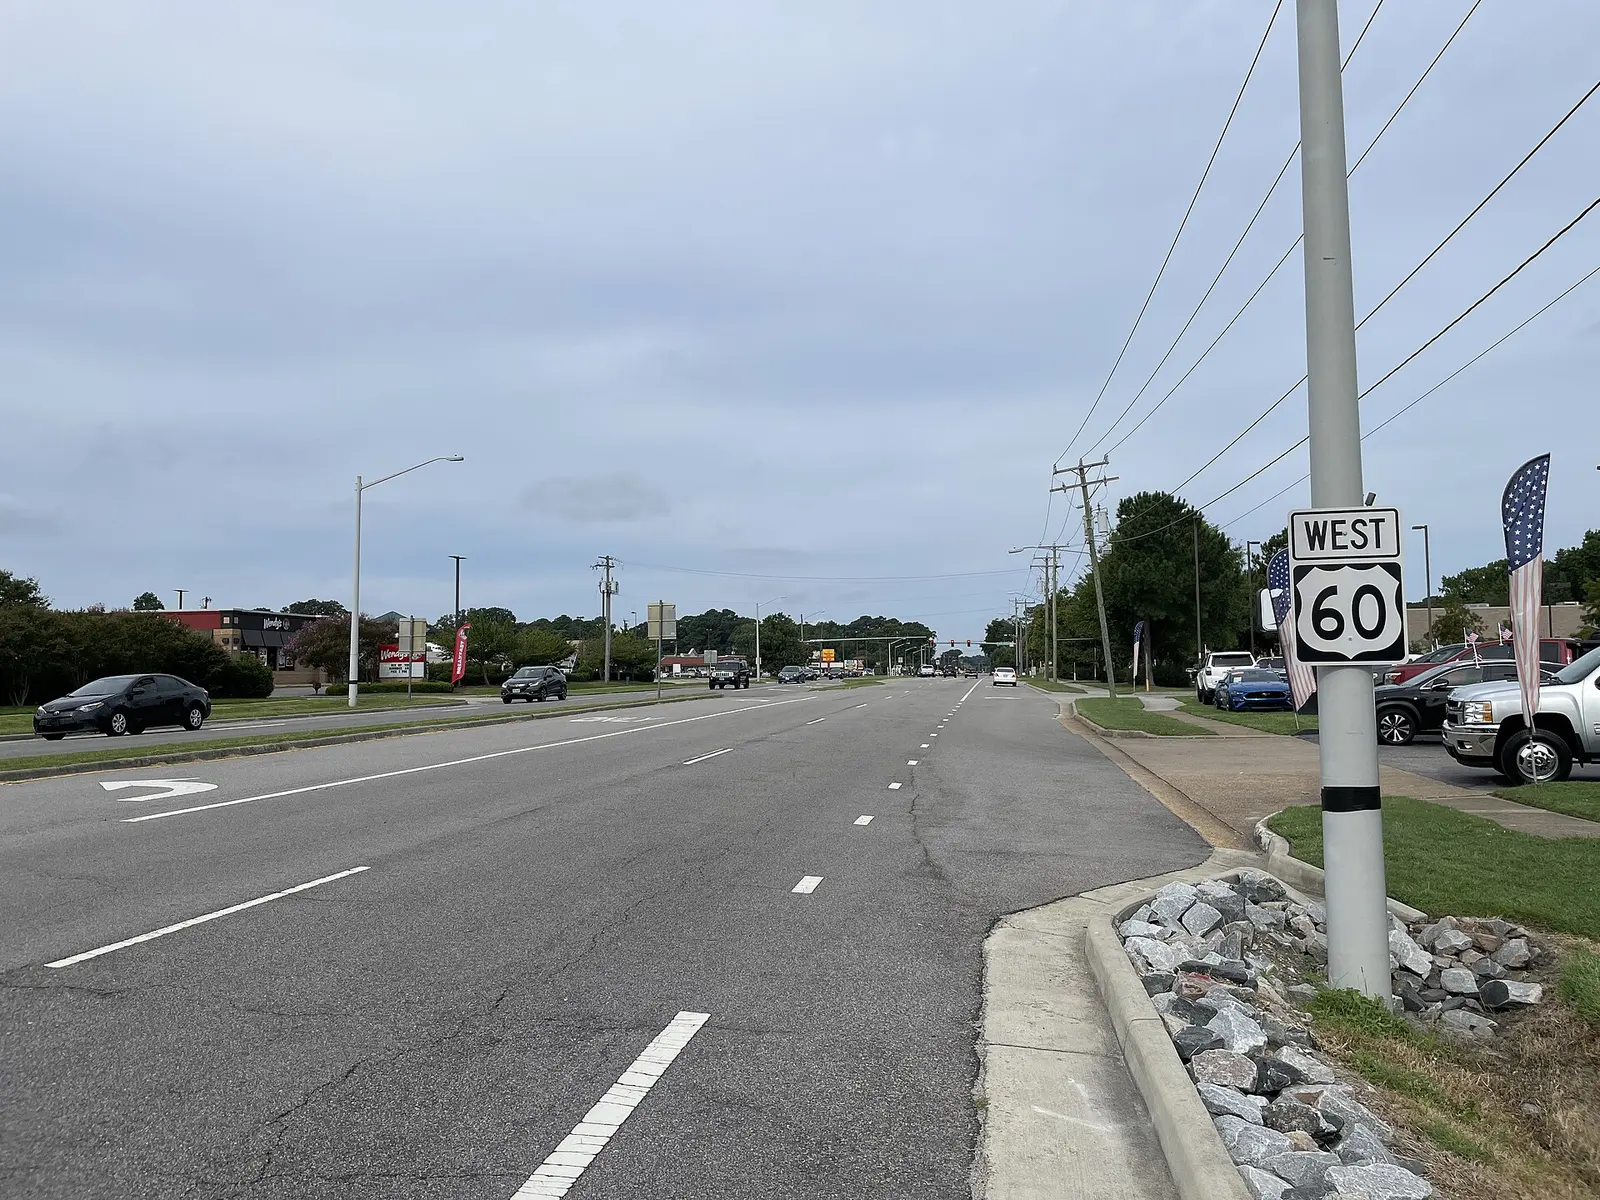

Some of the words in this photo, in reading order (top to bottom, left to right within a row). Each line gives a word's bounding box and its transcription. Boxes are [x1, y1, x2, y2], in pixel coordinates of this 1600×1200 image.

[1304, 518, 1386, 551] WEST
[1312, 584, 1387, 641] 60
[456, 641, 465, 675] BREAKFAST
